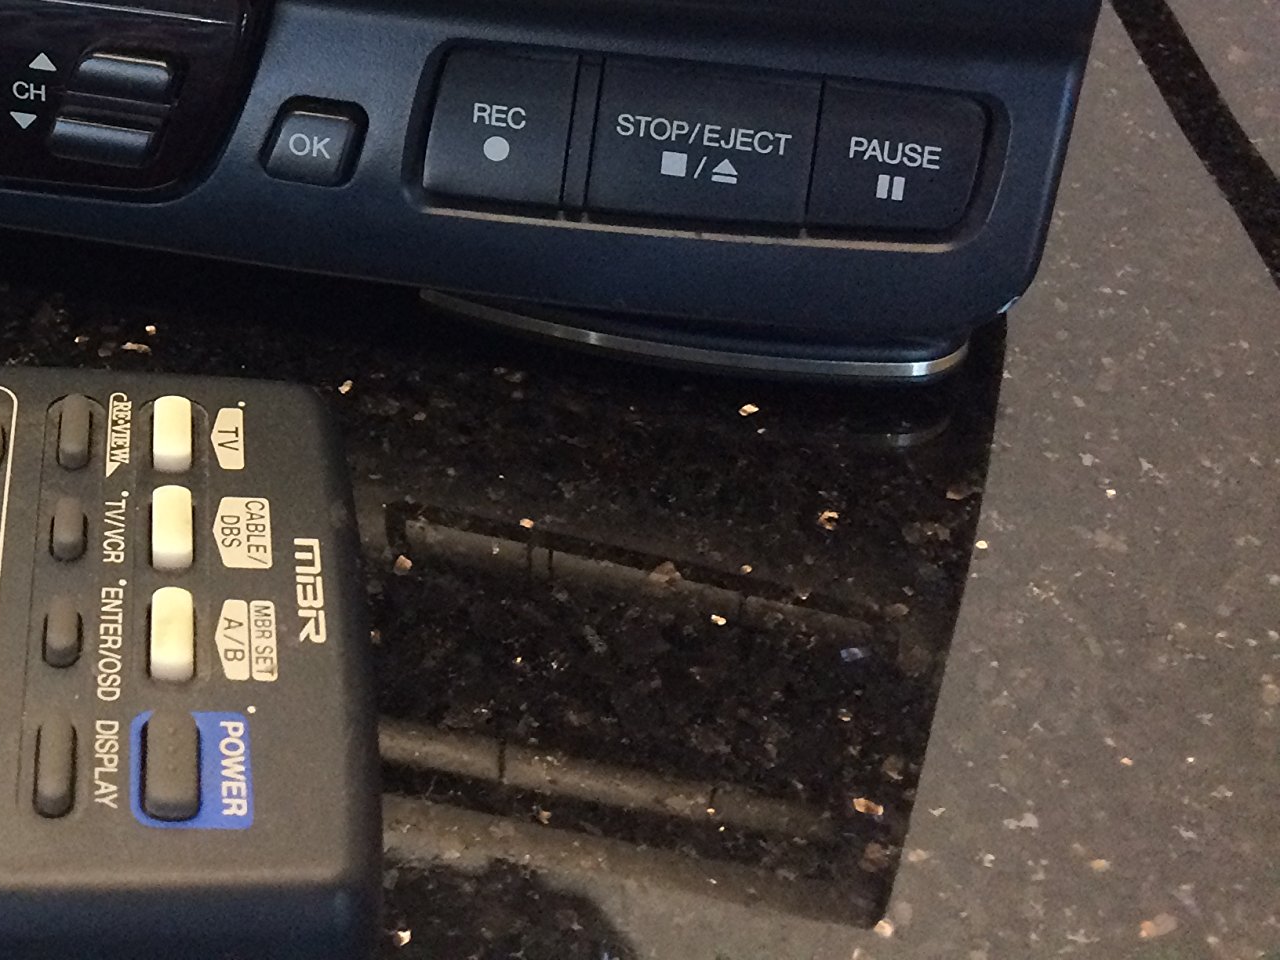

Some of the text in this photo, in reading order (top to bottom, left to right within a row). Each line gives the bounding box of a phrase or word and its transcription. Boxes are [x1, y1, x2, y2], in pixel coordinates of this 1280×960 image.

[12, 81, 46, 102] CH
[472, 103, 526, 130] REC
[616, 113, 792, 157] STOP/EJECT
[288, 133, 331, 160] OK
[849, 137, 942, 171] PAUSE
[218, 425, 240, 452] TV
[102, 499, 127, 564] TV/VCR
[220, 513, 242, 548] DBS
[244, 500, 269, 566] CABLE/
[96, 586, 124, 702] ENTER/OSD
[223, 616, 246, 663] A/B
[253, 604, 275, 677] MBR SET
[94, 720, 120, 809] DISPLAY
[219, 720, 249, 817] POWER
